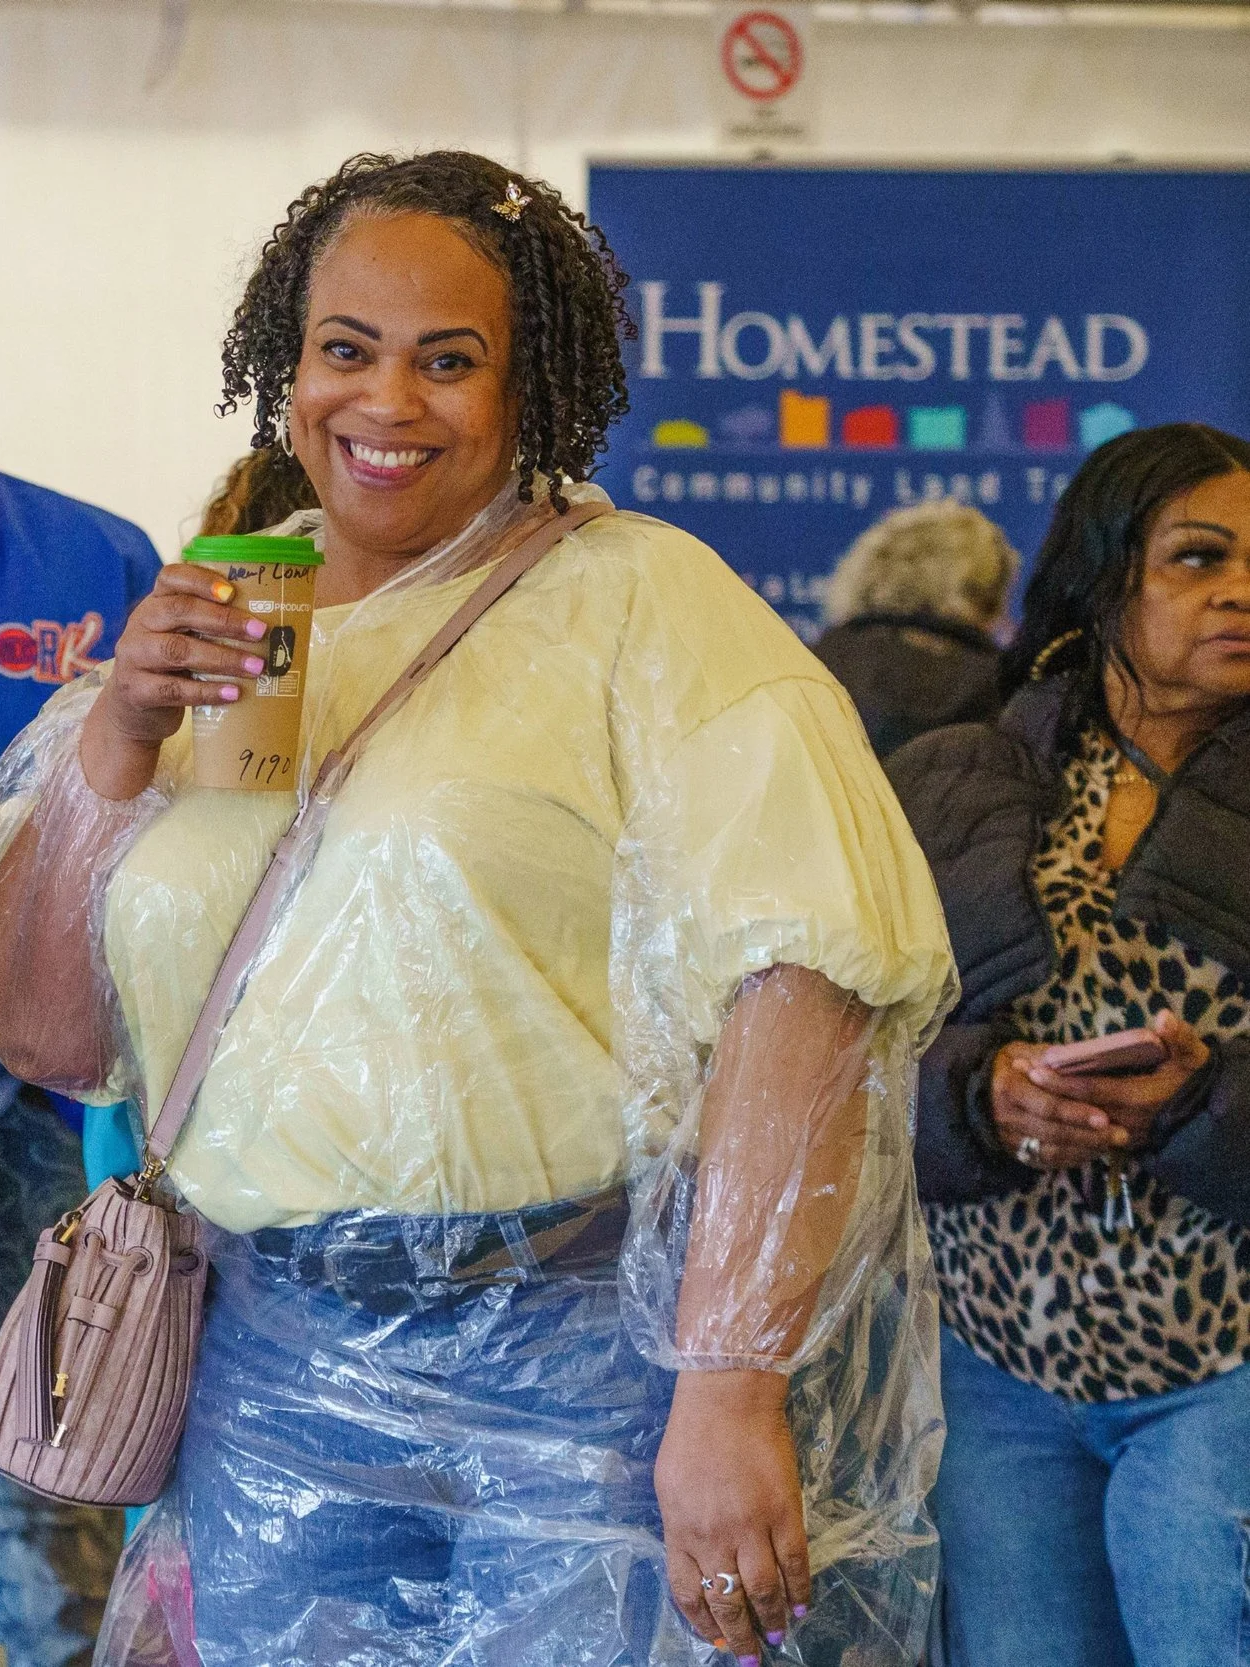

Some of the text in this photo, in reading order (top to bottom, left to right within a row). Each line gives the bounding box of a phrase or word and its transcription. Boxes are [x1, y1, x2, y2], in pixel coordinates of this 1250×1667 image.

[638, 280, 1150, 382] HOMESTEAD
[632, 465, 872, 509] Community
[893, 467, 1002, 503] Land
[239, 749, 291, 784] 9190
